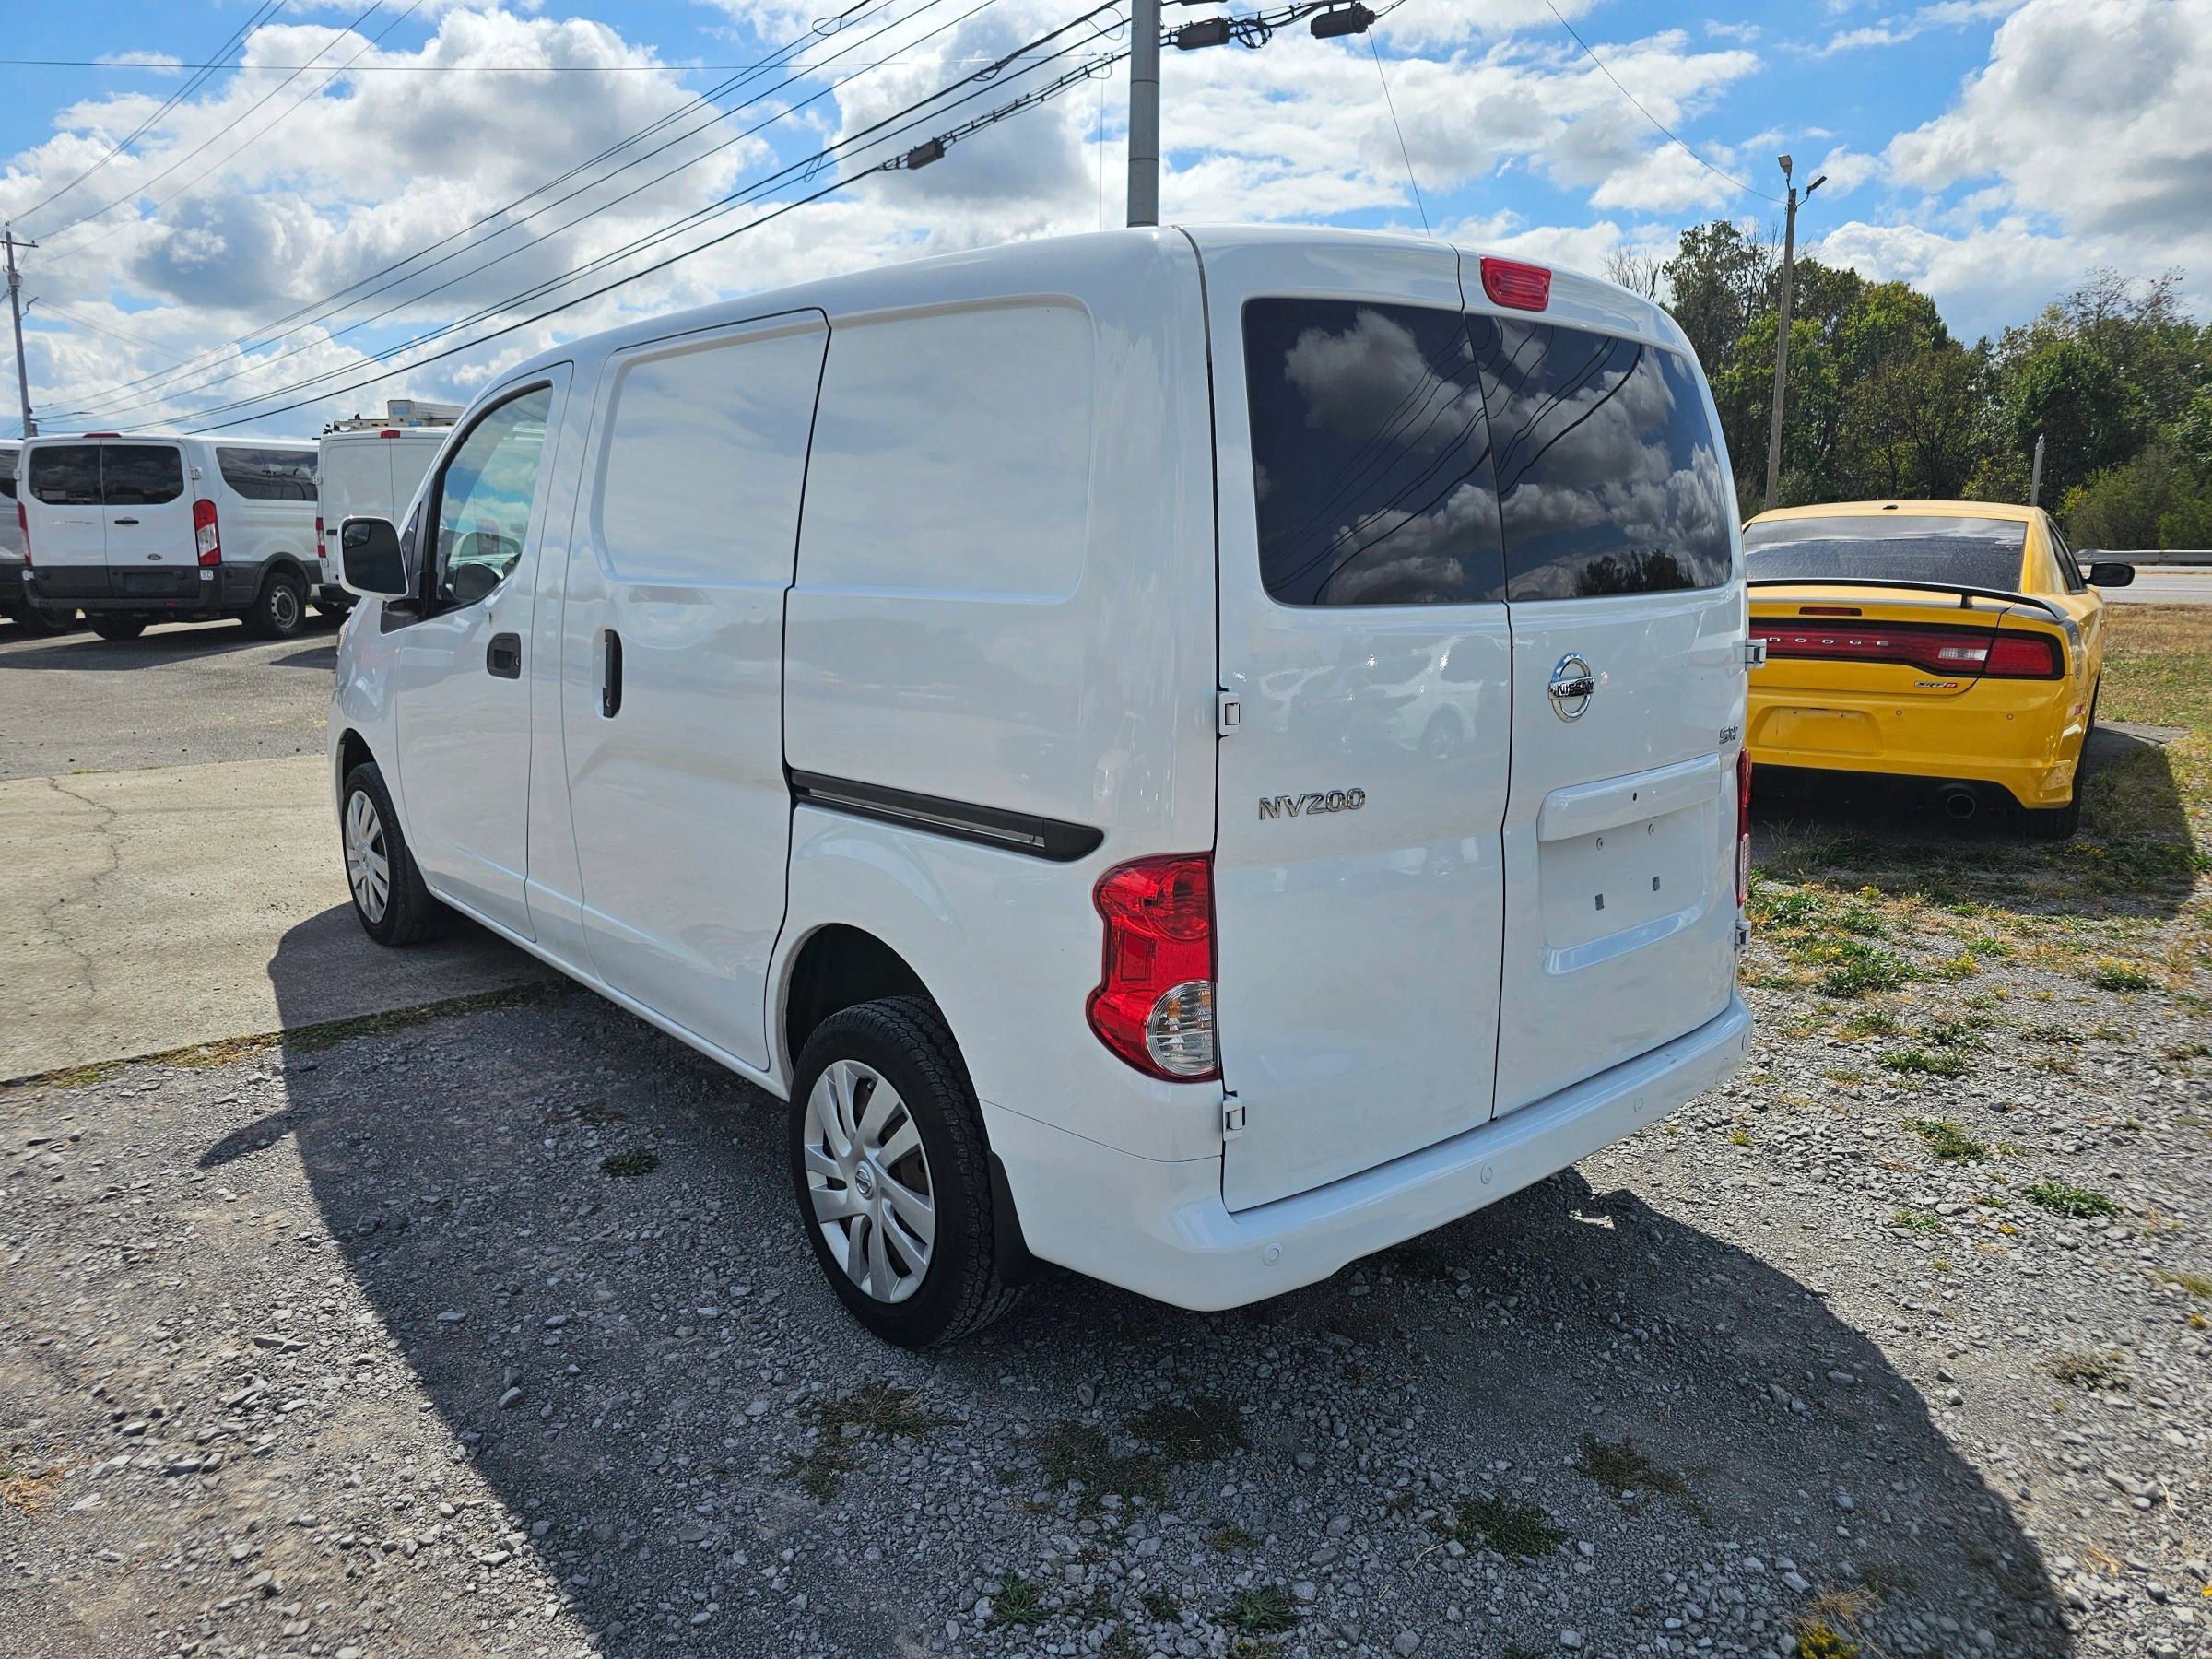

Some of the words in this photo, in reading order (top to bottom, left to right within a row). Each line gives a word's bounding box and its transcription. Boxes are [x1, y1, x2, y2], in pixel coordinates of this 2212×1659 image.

[1769, 637, 1888, 647] DODGE
[1558, 680, 1594, 696] NISSAN
[1719, 724, 1738, 745] SV
[1258, 787, 1366, 820] NV200
